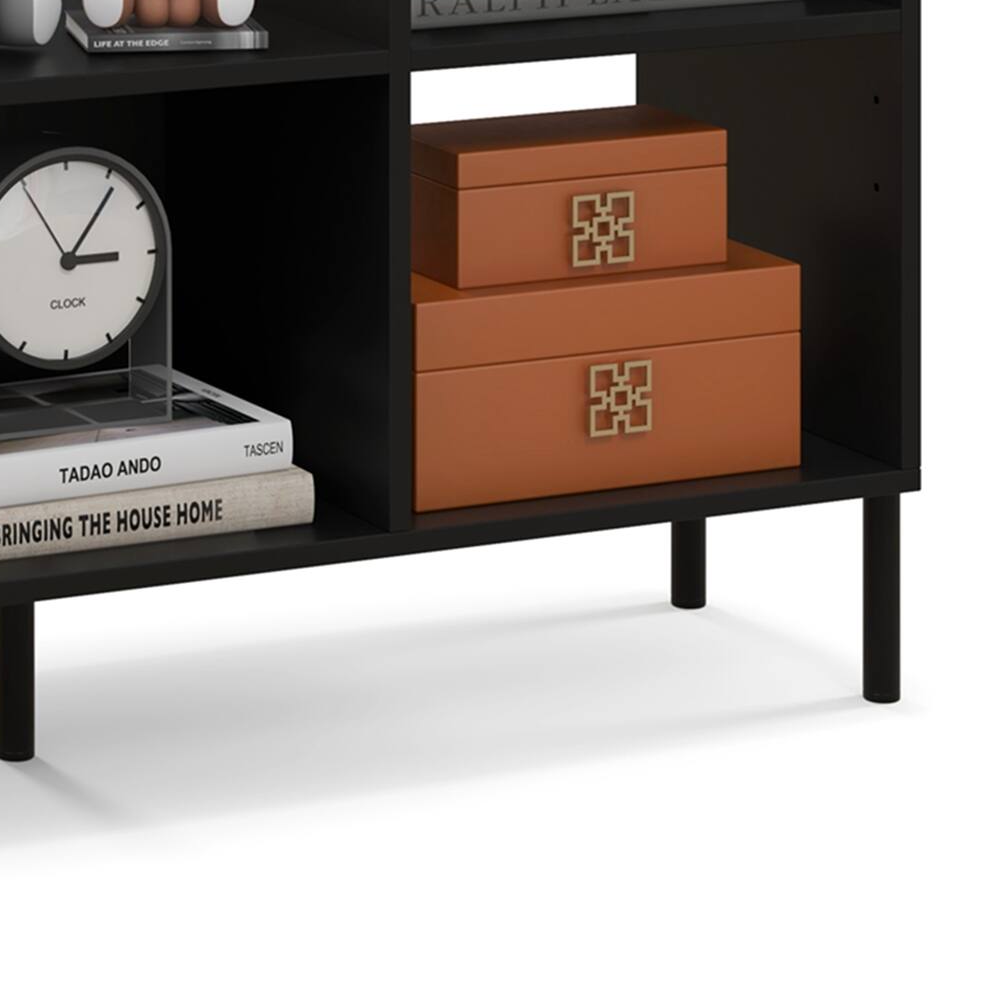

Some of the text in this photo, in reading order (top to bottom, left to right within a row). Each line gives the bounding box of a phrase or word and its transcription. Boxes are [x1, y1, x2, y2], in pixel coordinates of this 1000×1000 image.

[93, 40, 112, 48] LIFE
[145, 39, 169, 47] EDGE
[50, 297, 86, 310] CLOCK
[243, 440, 284, 458] TASCEN
[59, 456, 162, 485] TADAO ANDO
[79, 511, 111, 537] THE
[117, 504, 171, 532] HOUSE
[177, 498, 223, 526] HOME
